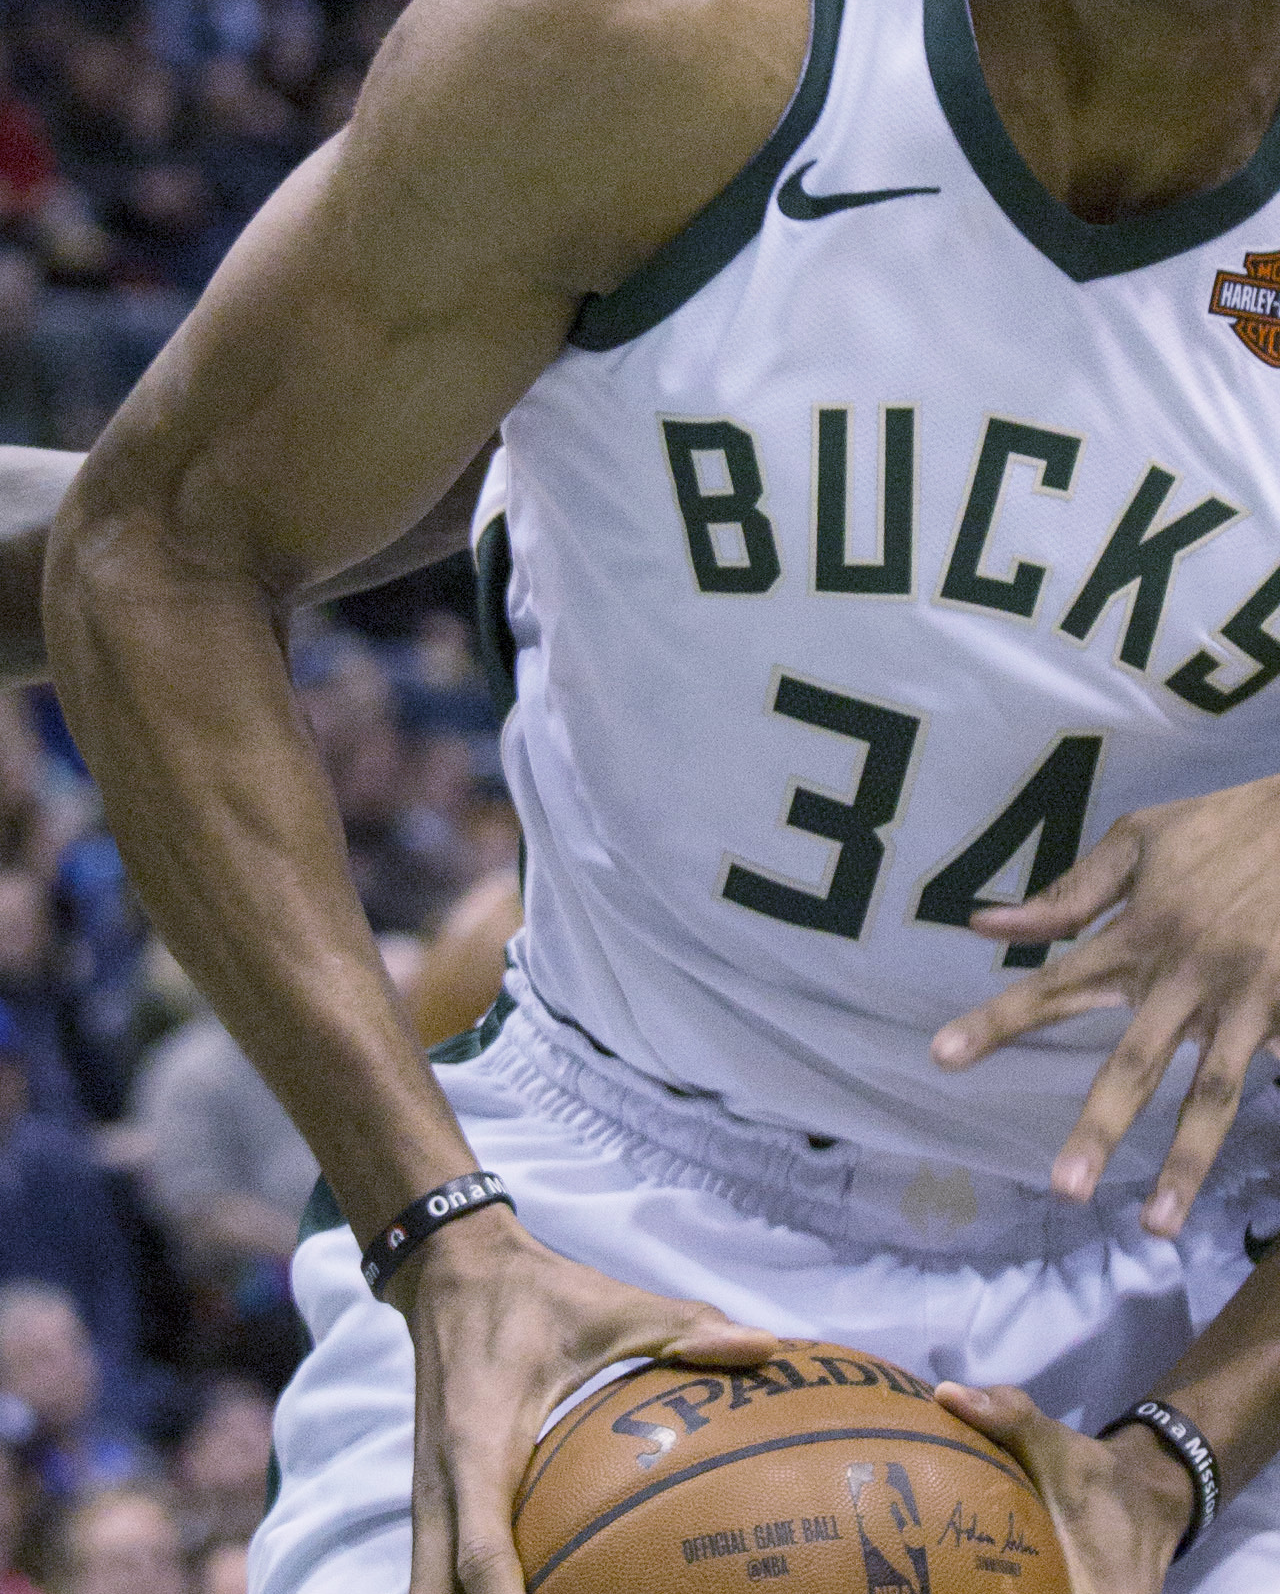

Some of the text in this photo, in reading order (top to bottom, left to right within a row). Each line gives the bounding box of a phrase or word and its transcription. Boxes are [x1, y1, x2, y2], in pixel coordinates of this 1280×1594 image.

[718, 663, 1112, 971] 34
[426, 1191, 468, 1218] On
[468, 1183, 486, 1199] a
[611, 1356, 936, 1470] SPALDIN
[1137, 1402, 1172, 1425] On
[1170, 1422, 1187, 1440] a
[681, 1514, 844, 1565] OFFICIAL GAME BALL
[746, 1554, 791, 1583] @NBA
